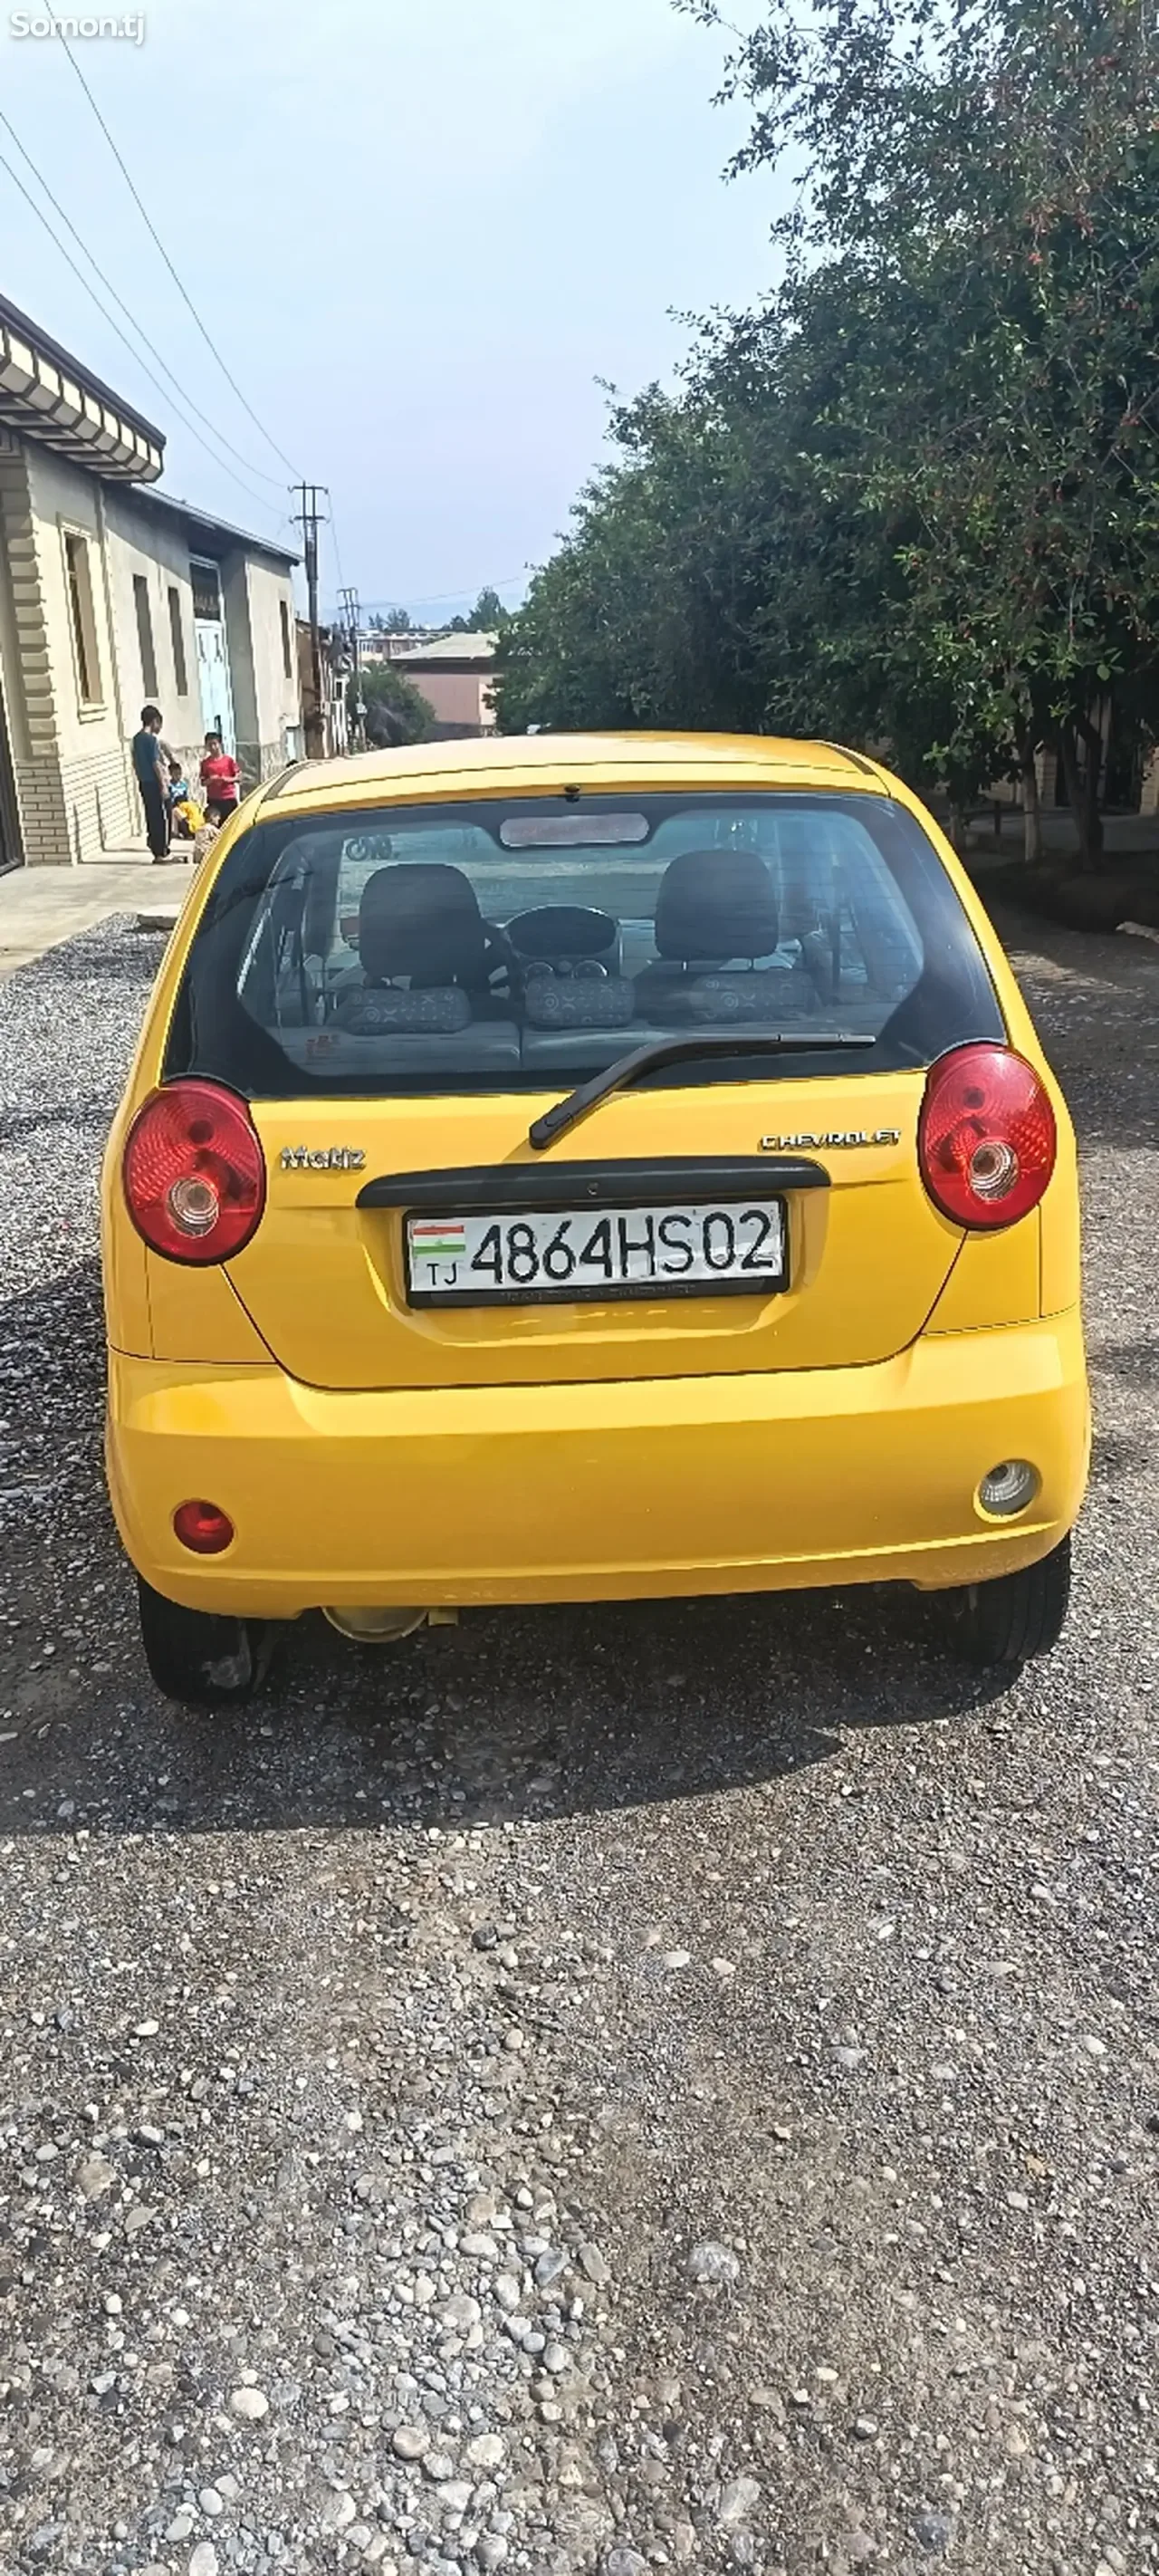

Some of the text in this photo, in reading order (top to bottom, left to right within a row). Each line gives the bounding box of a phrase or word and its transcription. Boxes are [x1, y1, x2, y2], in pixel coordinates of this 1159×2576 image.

[761, 1129, 902, 1151] CHEVROLET
[280, 1145, 367, 1169] Matiz
[471, 1209, 774, 1284] 4864HS02
[426, 1262, 458, 1286] TJ
